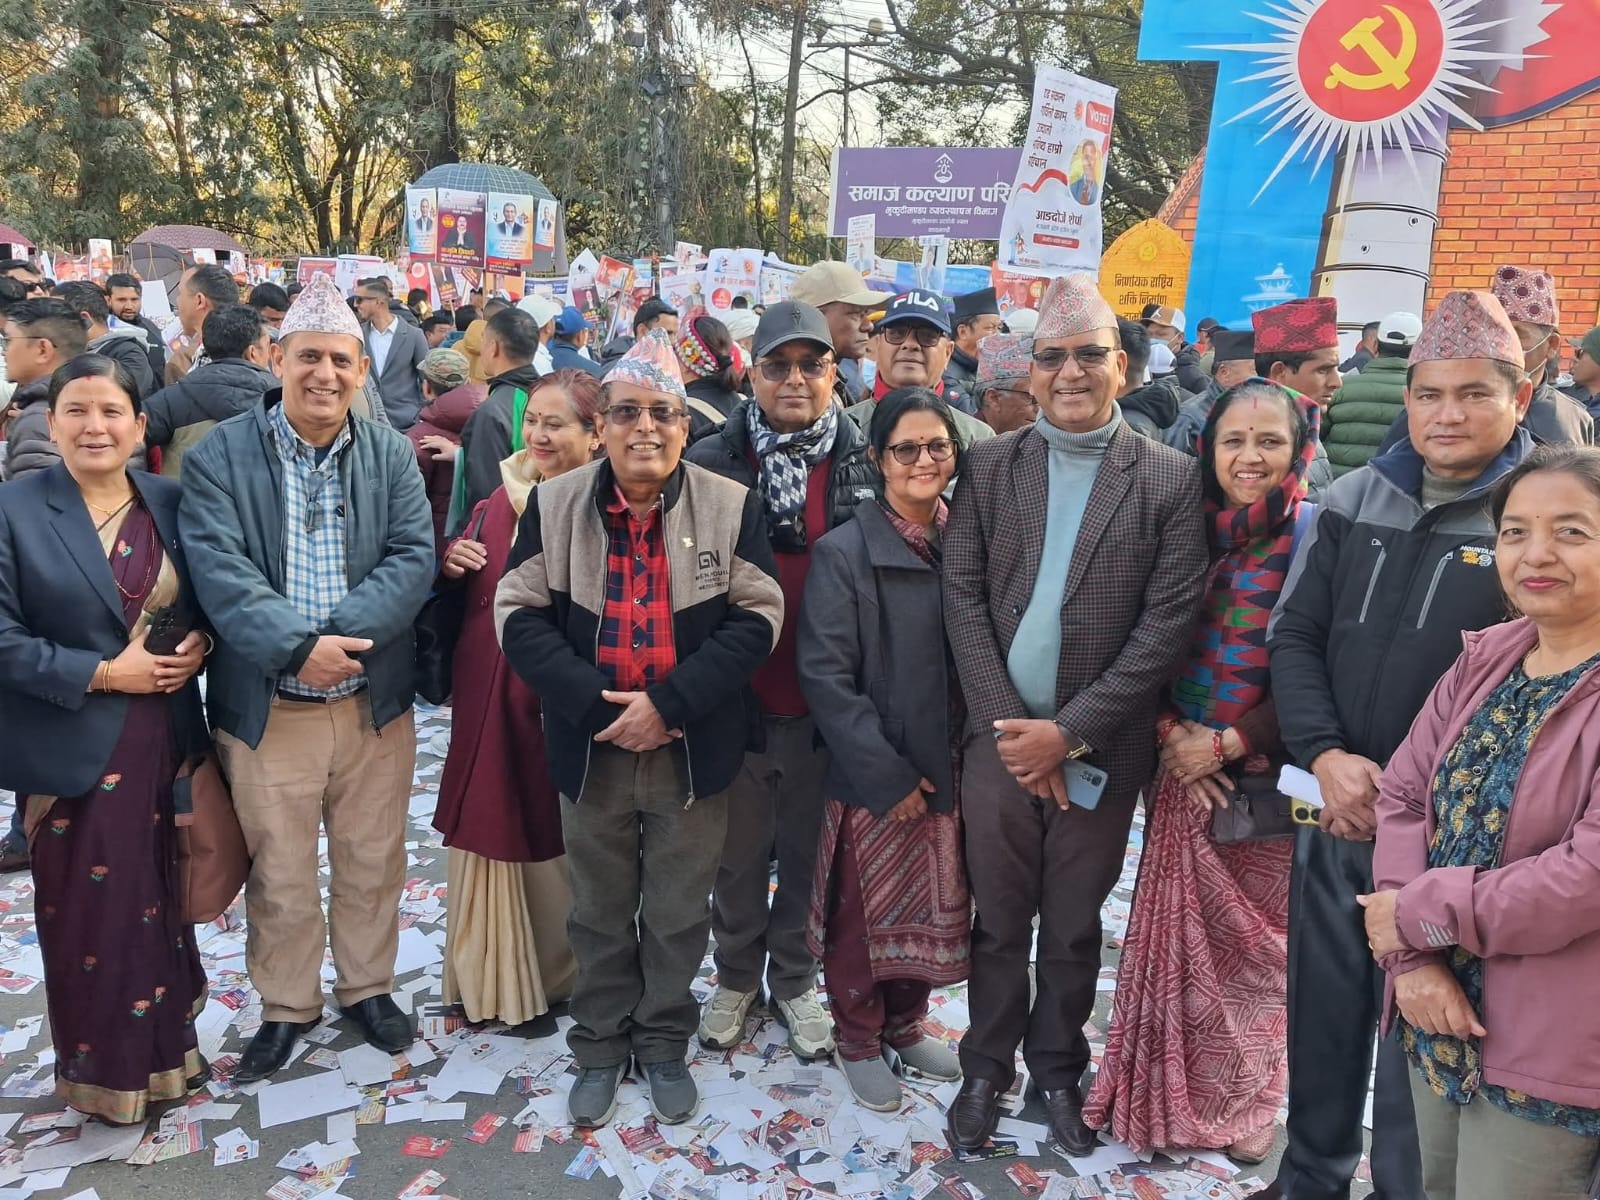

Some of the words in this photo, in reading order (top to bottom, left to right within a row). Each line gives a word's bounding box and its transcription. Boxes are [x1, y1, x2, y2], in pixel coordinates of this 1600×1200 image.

[848, 186, 901, 202] समाज
[905, 186, 976, 203] कल्याण
[980, 182, 1012, 203] परि
[893, 291, 939, 312] FILA
